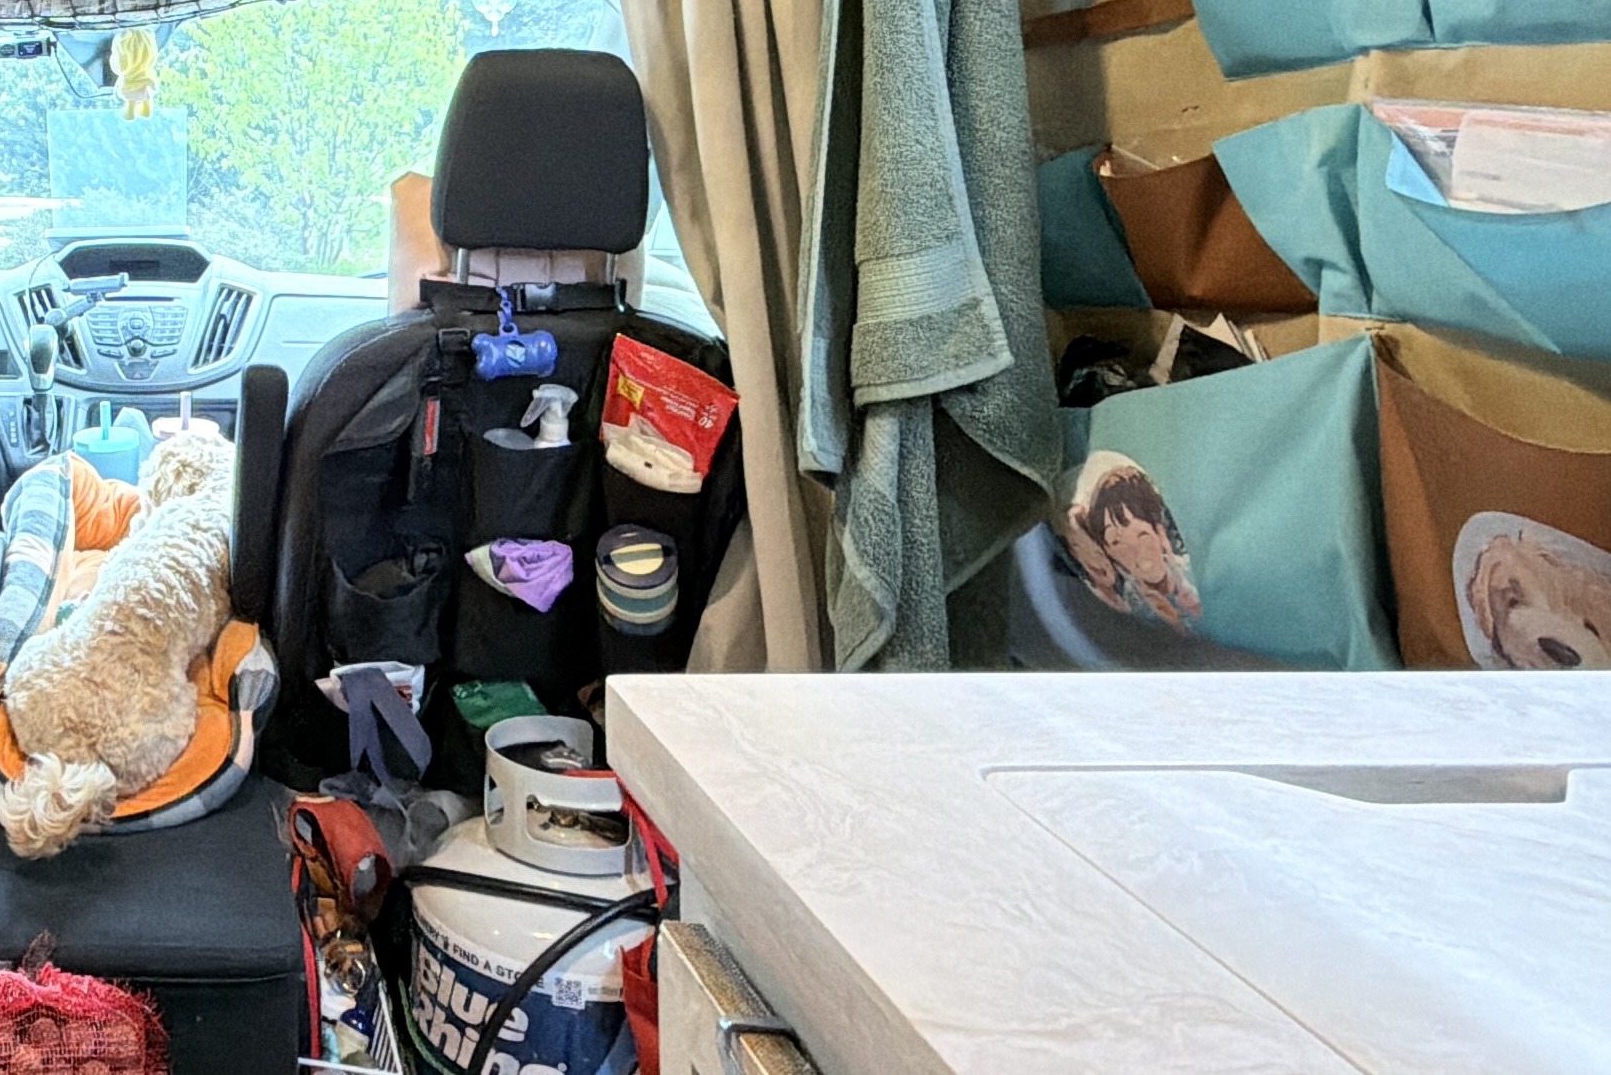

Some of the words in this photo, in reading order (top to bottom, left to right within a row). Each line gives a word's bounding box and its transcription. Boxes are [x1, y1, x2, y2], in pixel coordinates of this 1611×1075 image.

[418, 942, 529, 1042] Blue
[452, 942, 479, 966] FIND
[483, 958, 493, 973] A
[496, 964, 544, 989] STOE
[413, 992, 567, 1075] Rhin
